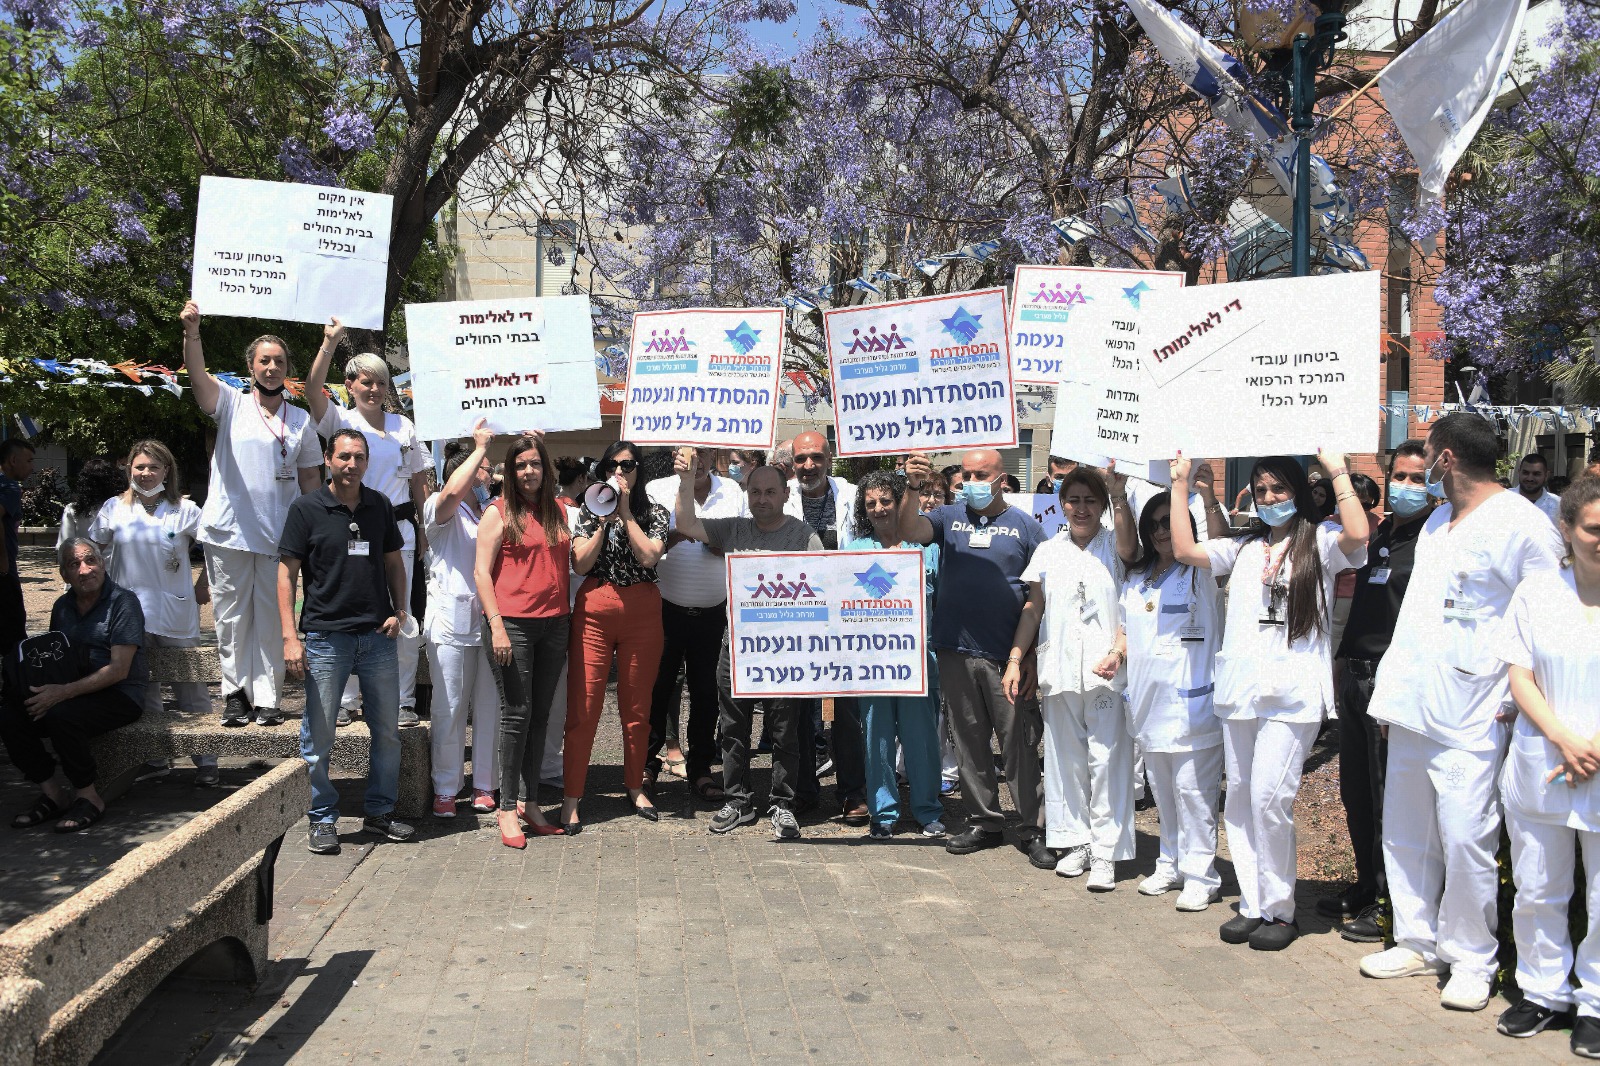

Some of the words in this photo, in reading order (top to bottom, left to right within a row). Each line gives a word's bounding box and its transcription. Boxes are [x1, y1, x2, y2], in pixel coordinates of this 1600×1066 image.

[318, 192, 346, 204] מקום
[349, 196, 365, 207] אין
[316, 208, 363, 222] לאלימות
[303, 221, 342, 235] החולים
[345, 227, 374, 239] בבית
[317, 238, 356, 254] ובכלל!
[214, 250, 244, 261] עובדי
[247, 253, 284, 264] ביטחון
[207, 267, 246, 277] הרפואי
[250, 269, 286, 280] המרכז
[219, 281, 245, 293] הכל!
[250, 282, 272, 295] מעל
[1223, 298, 1243, 313] די
[458, 310, 515, 325] לאלימות
[518, 311, 533, 322] די
[1111, 320, 1136, 332] עובדי
[455, 332, 502, 346] החולים
[506, 332, 541, 343] בבתי
[1014, 332, 1064, 349] נעמת
[1152, 311, 1222, 363] לאלימות!
[930, 342, 1000, 359] ההסתדרות
[1105, 339, 1135, 350] הרפואי
[709, 354, 771, 365] ההסתדרות
[1112, 355, 1133, 370] הכל!
[1251, 354, 1288, 366] עובדי
[1294, 351, 1340, 367] ביטחון
[854, 366, 873, 374] מערבי
[872, 364, 888, 373] גליל
[889, 363, 907, 372] מרחב
[464, 373, 521, 390] לאלימות
[524, 373, 539, 385] די
[1245, 375, 1293, 387] הרפואי
[1298, 372, 1345, 384] המרכז
[512, 395, 546, 406] בבתי
[631, 386, 674, 405] ונעמת
[677, 387, 770, 405] ההסתדרות
[841, 389, 897, 412] ונעמת
[901, 381, 1005, 408] ההסתדרות
[1106, 389, 1139, 403] תדרות
[1261, 393, 1294, 407] הכל!
[1299, 392, 1328, 406] מעל
[461, 396, 508, 411] החולים
[1097, 408, 1123, 421] תאבק
[632, 415, 672, 433] מערבי
[675, 411, 712, 433] גליל
[717, 417, 763, 435] מרחב
[904, 415, 946, 437] גליל
[951, 414, 1003, 434] מרחב
[848, 422, 901, 441] מערבי
[1098, 426, 1130, 443] איתכם!
[840, 598, 913, 610] ההסתדרות
[779, 610, 794, 619] גליל
[740, 635, 802, 654] ונעמת
[808, 633, 916, 652] ההסתדרות
[746, 666, 805, 684] מערבי
[809, 661, 853, 682] גליל
[858, 664, 912, 681] מרחב
